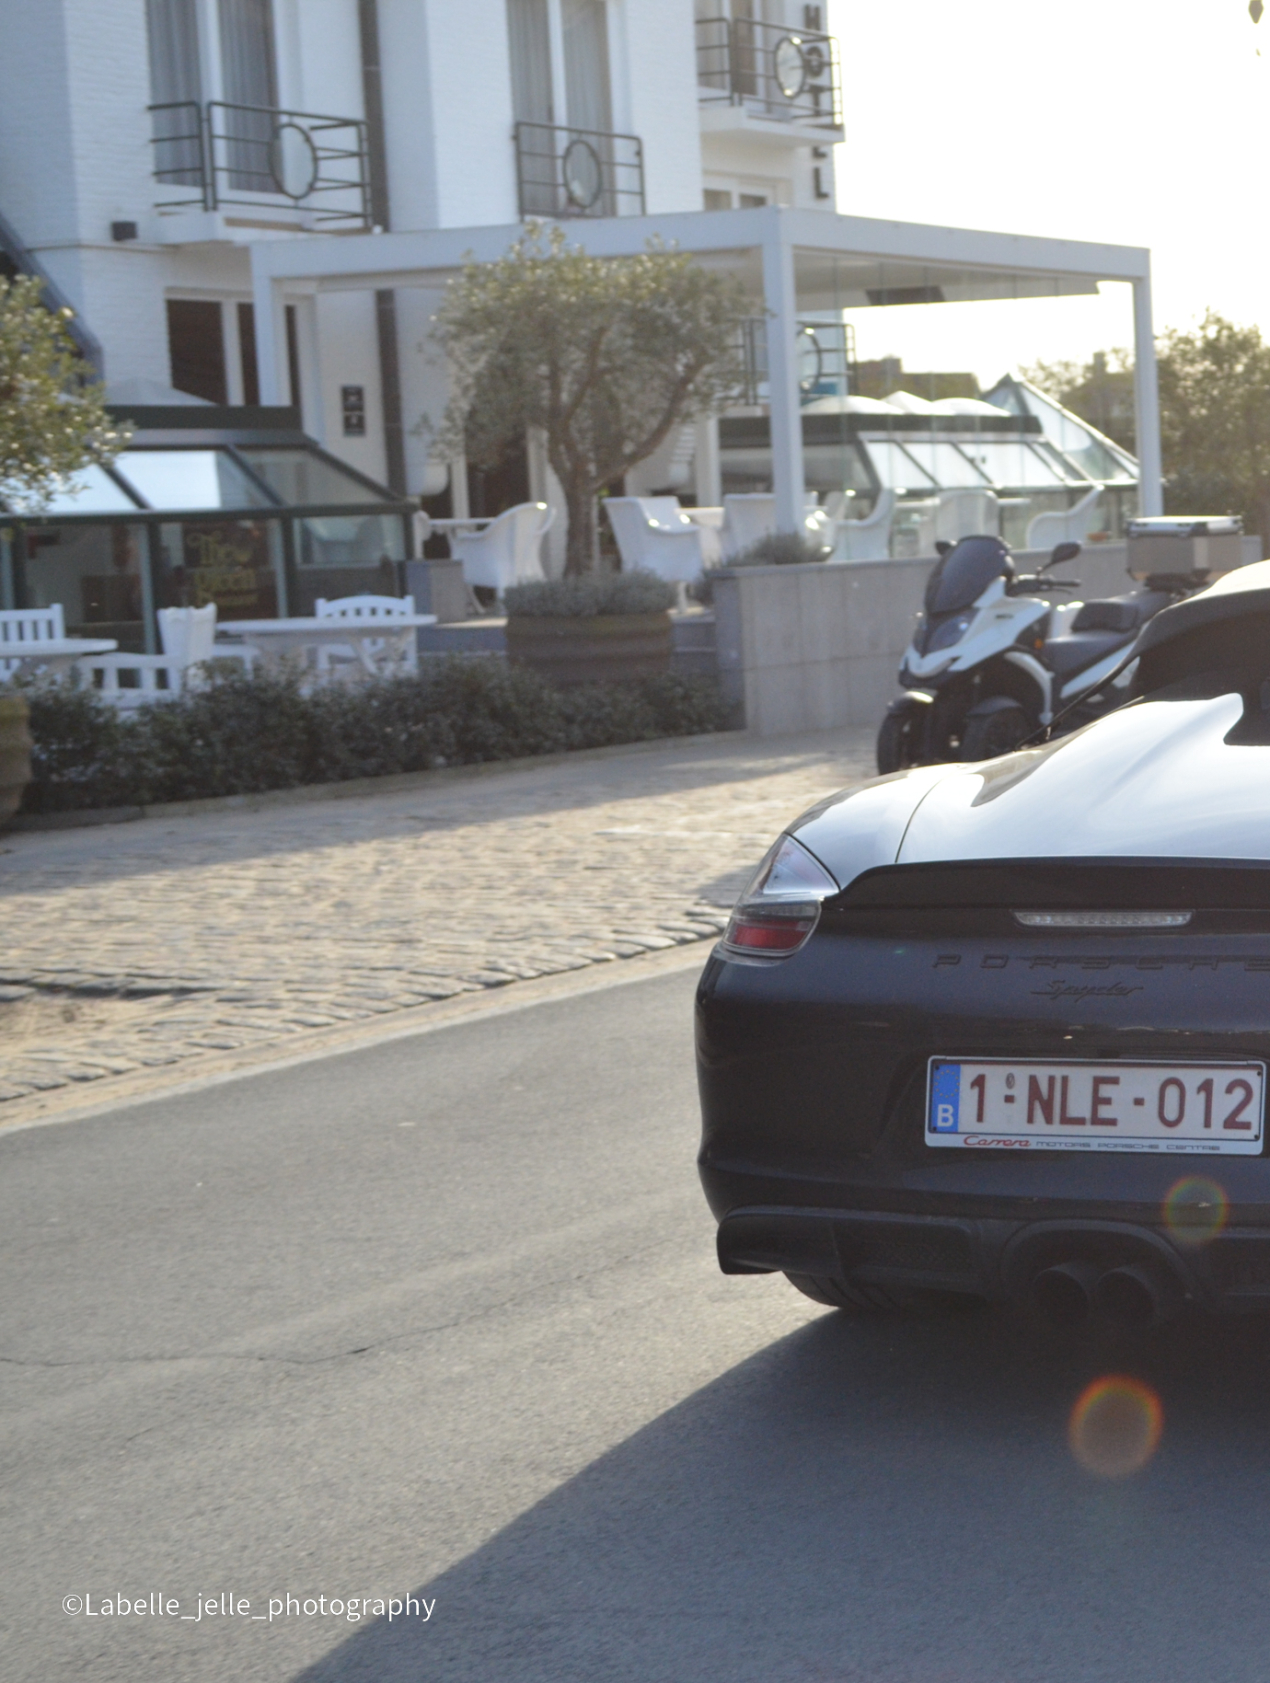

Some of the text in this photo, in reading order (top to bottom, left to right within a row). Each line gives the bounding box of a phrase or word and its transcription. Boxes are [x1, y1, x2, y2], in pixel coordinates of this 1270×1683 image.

[1030, 979, 1145, 1004] Spyder
[936, 1103, 954, 1127] B
[963, 1133, 1221, 1151] Carrera MOTORS PORSCHE CENTRE
